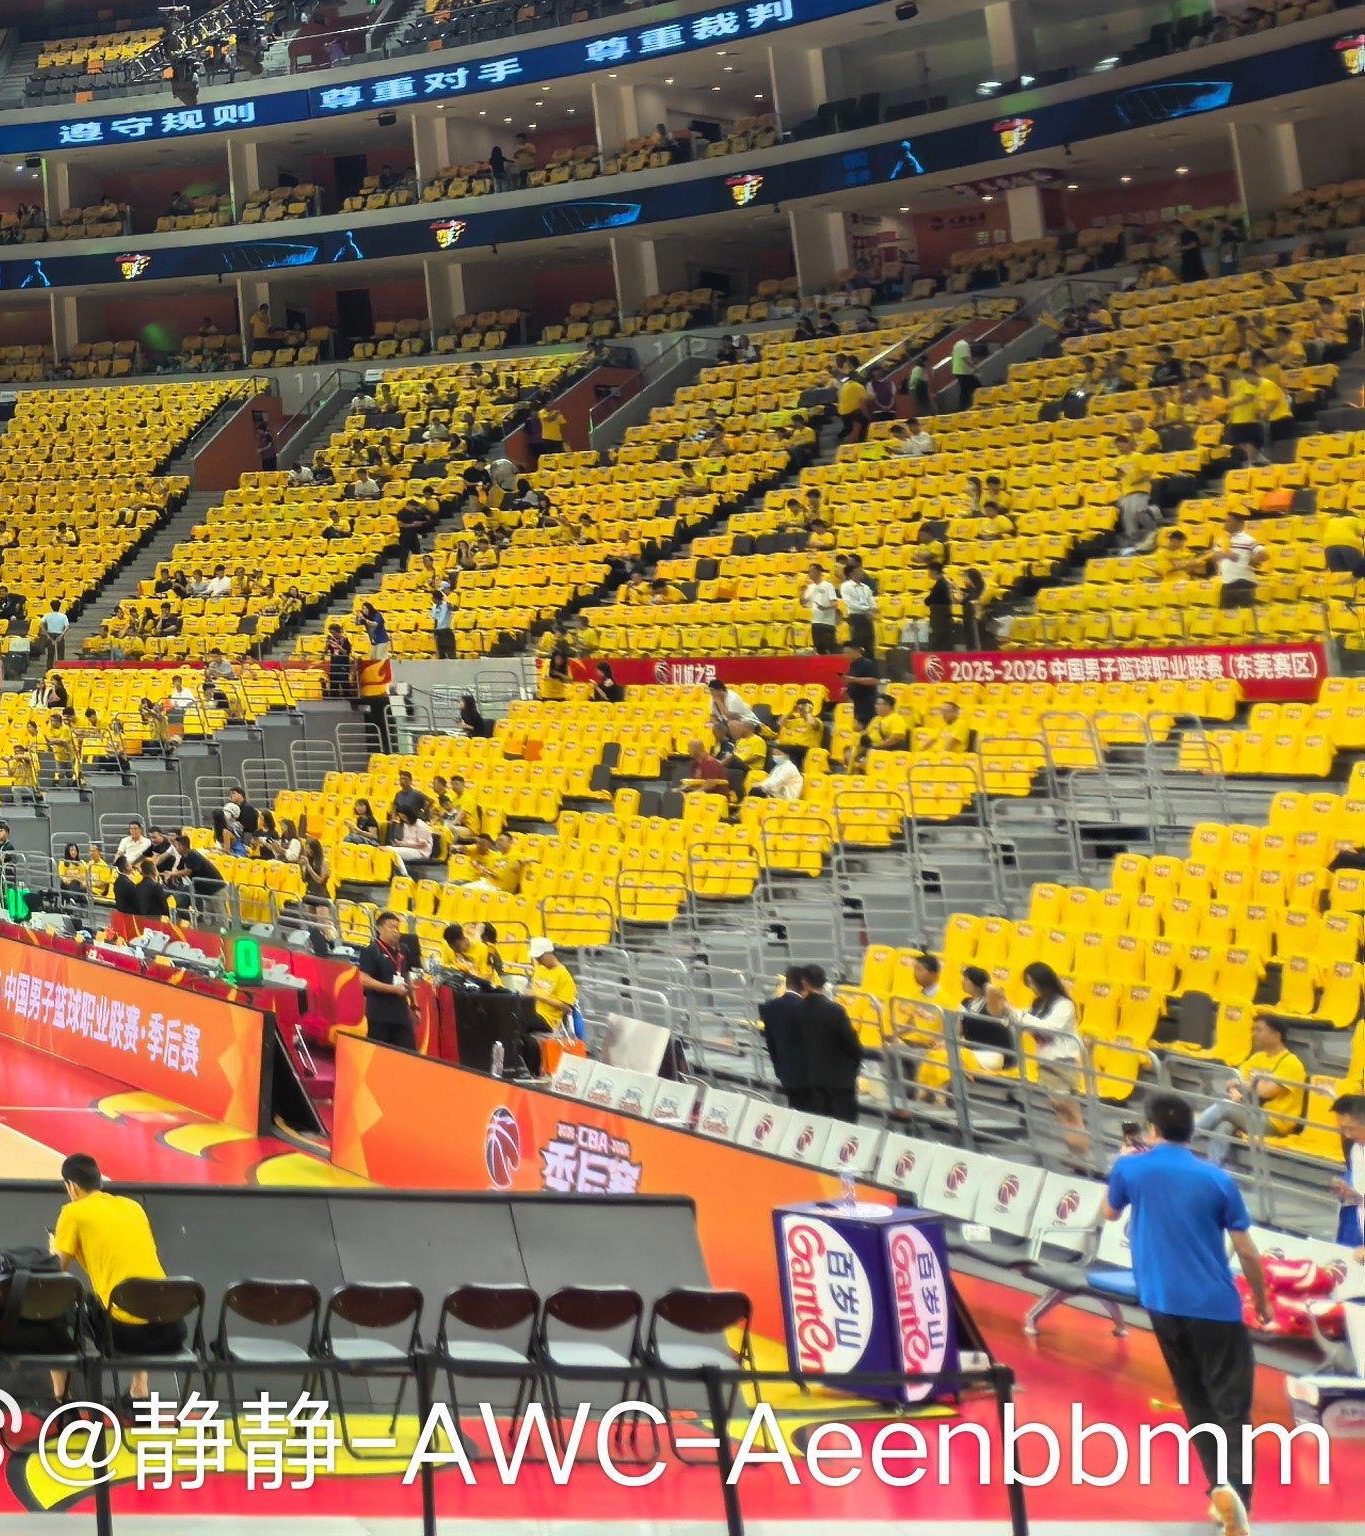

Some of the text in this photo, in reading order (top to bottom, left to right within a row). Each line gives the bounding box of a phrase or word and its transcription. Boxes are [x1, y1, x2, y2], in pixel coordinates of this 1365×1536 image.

[320, 56, 524, 111] 尊重对手
[58, 101, 255, 145] 遵守规则
[950, 658, 1048, 683] 2025-2026
[826, 1249, 862, 1350] 百岁山
[918, 1252, 946, 1350] 百岁山
